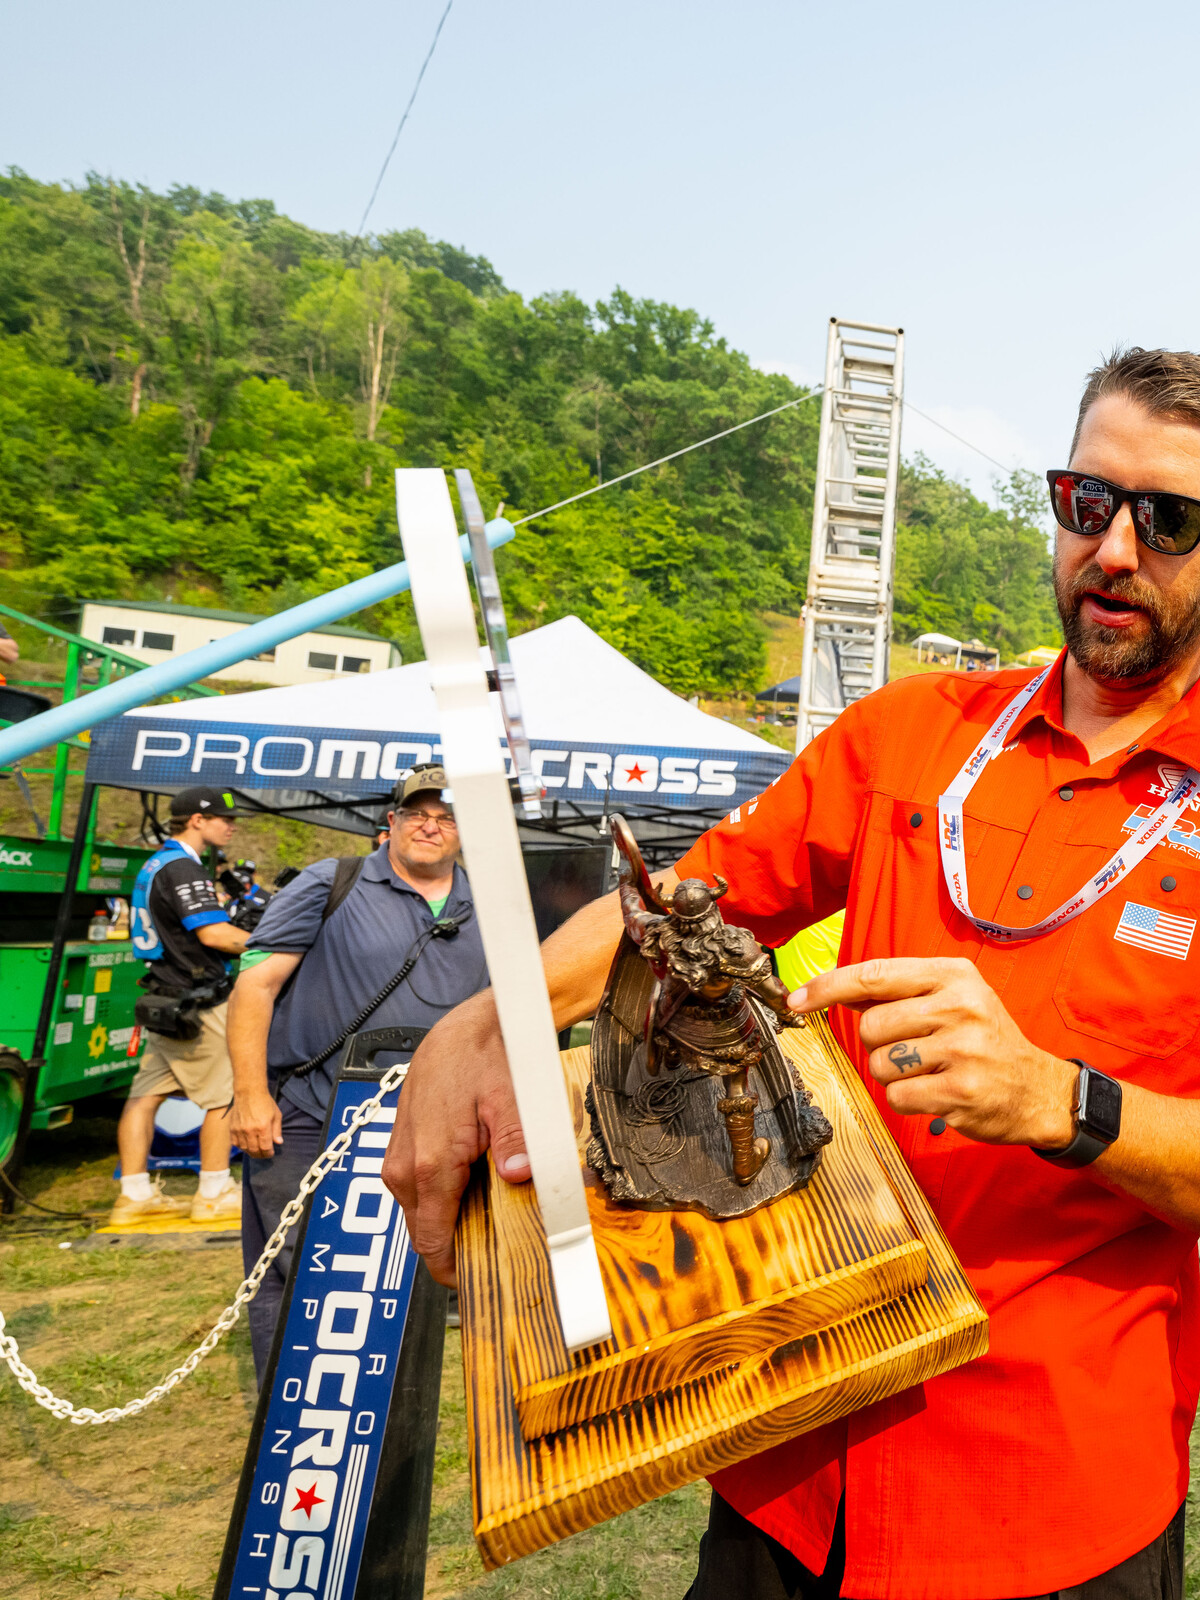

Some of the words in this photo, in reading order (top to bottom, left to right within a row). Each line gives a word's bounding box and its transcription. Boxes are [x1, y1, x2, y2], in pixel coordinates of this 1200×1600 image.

[991, 705, 1020, 738] HONDA
[132, 729, 740, 798] PROMOCROSS
[943, 813, 958, 852] HRC
[1135, 813, 1169, 846] HONDA
[1036, 897, 1086, 932] HONDA
[354, 1298, 398, 1435] PRO
